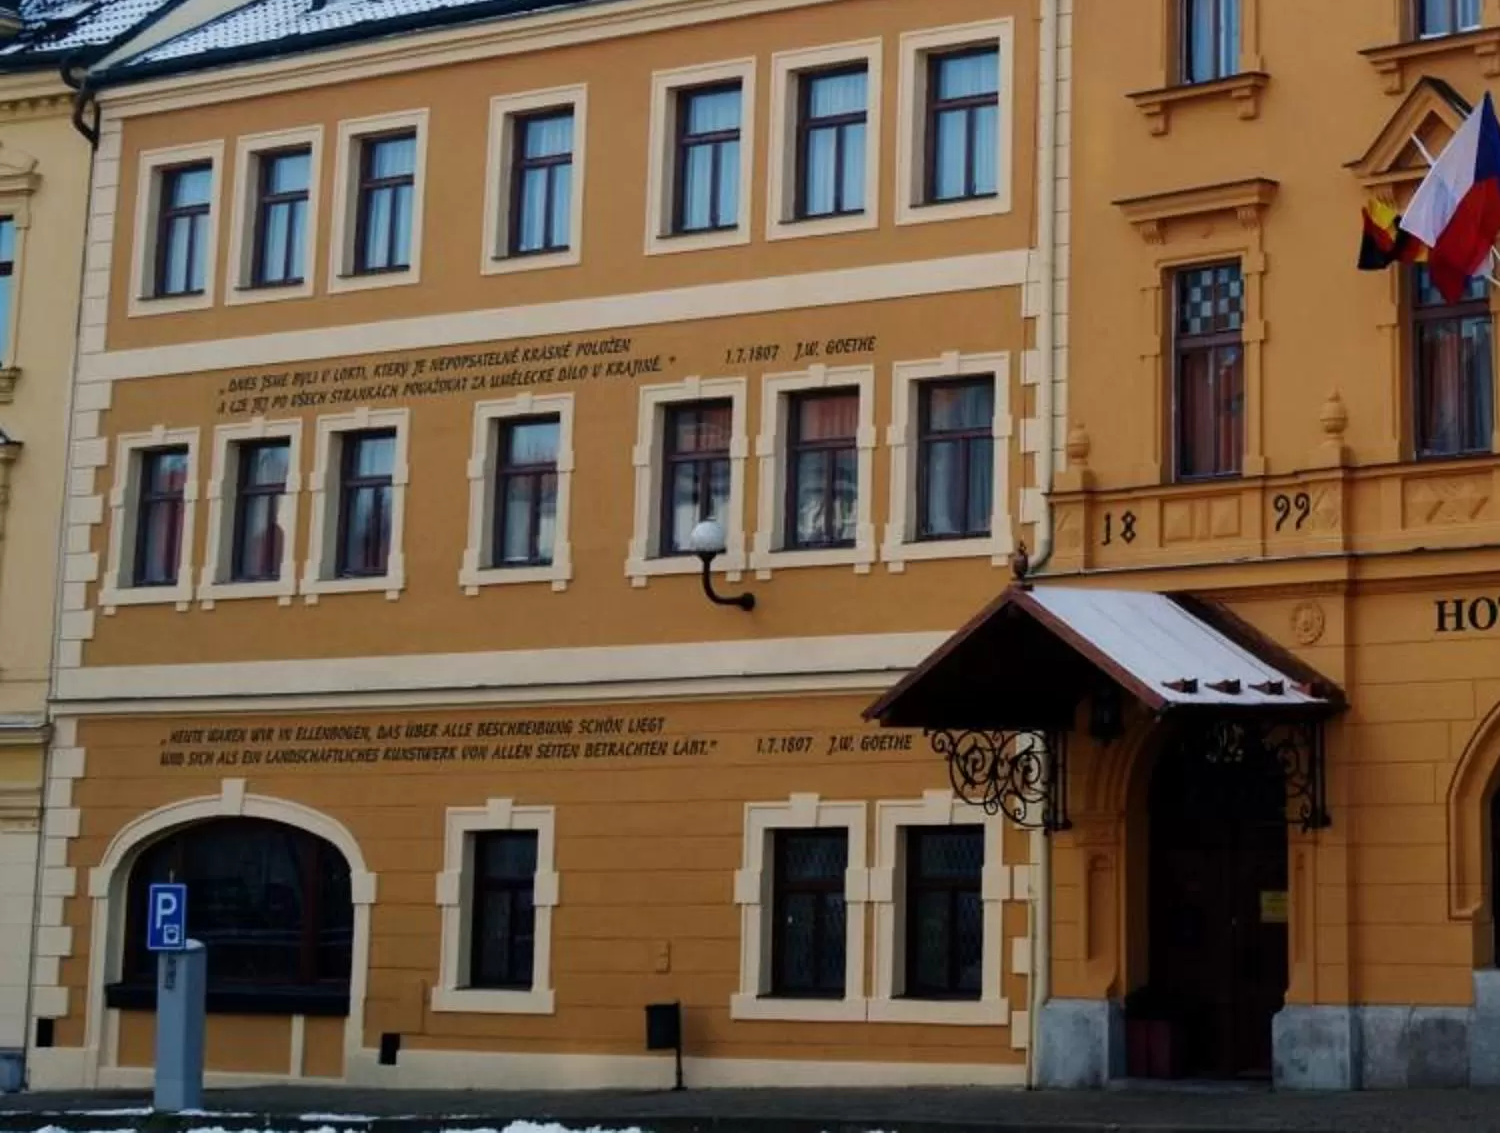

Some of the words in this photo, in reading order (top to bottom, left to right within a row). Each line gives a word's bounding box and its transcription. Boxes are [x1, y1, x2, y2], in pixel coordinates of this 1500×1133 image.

[725, 344, 780, 365] 1.7.1807
[825, 335, 877, 356] GOETHE
[411, 359, 426, 377] JE
[470, 375, 486, 390] ZA
[1102, 510, 1136, 546] 18
[1273, 492, 1311, 532] 99
[251, 726, 275, 743] WIR
[376, 724, 401, 740] DAS
[441, 722, 473, 738] ALLE
[477, 719, 574, 737] BESCHREIBUNG
[627, 716, 666, 734] LIEGT
[159, 751, 185, 766] UND
[215, 750, 239, 765] ALS
[241, 749, 263, 765] EIN
[382, 746, 457, 761] KUNSTWERK
[461, 744, 489, 761] VON
[491, 743, 533, 760] ALLEN
[535, 742, 581, 759] SEITEN
[584, 740, 669, 758] BETRACHTEN
[756, 735, 815, 754] 1.7.1807
[859, 733, 913, 752] GOETHE
[156, 892, 177, 930] P
